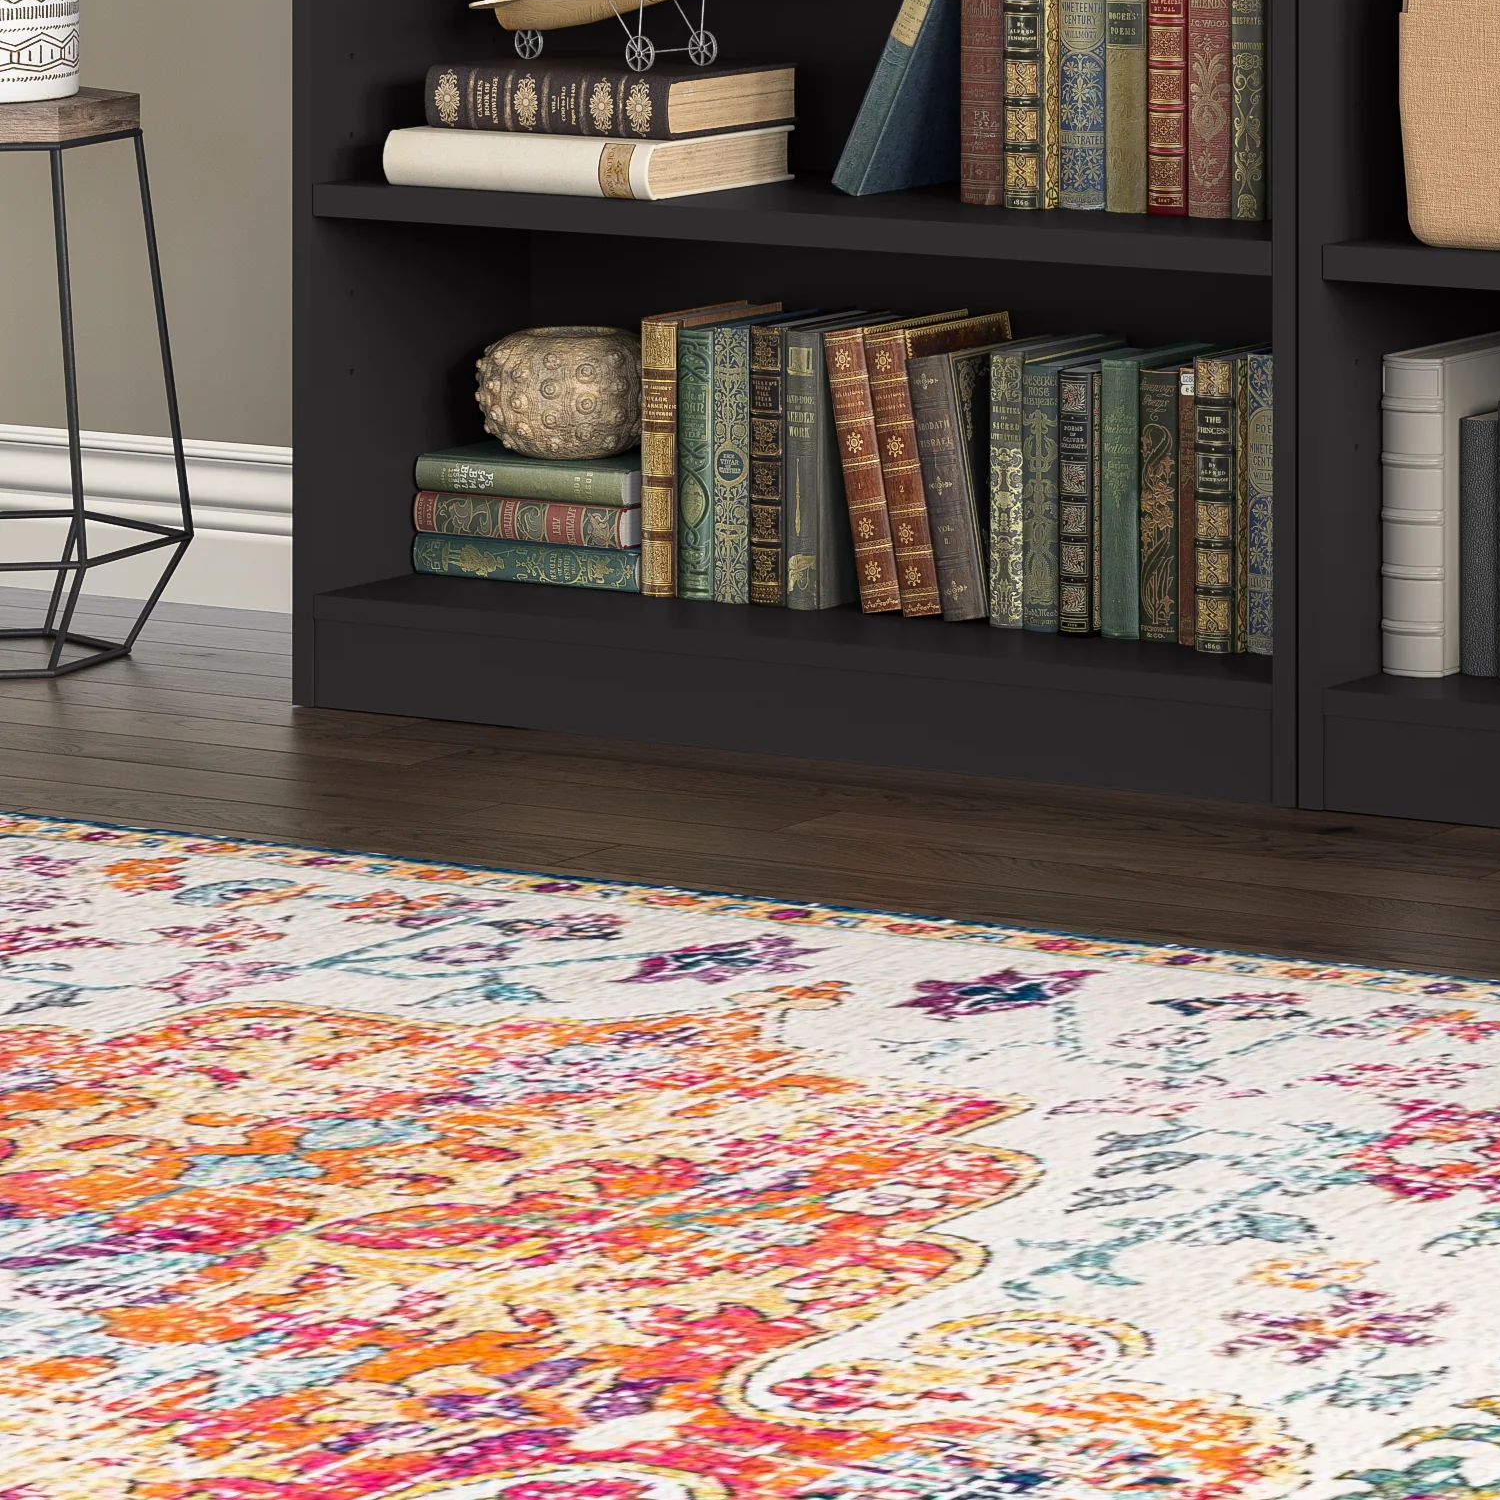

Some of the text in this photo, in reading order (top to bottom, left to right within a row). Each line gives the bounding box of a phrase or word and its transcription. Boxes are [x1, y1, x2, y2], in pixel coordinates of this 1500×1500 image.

[1061, 2, 1103, 13] NINETEENTH
[1064, 14, 1098, 25] CENTURY
[1110, 27, 1136, 36] POEMS
[484, 81, 490, 92] OF
[491, 75, 499, 124] KNOWLEDGE
[787, 411, 815, 423] NEEDLE
[1204, 416, 1222, 424] THE
[1262, 415, 1272, 423] TH
[788, 426, 811, 438] WORK
[992, 422, 1020, 431] SACRED
[1255, 423, 1272, 433] POE
[1250, 442, 1273, 454] NINETE
[1253, 456, 1272, 467] CENT
[484, 472, 494, 488] PS
[899, 484, 904, 493] 2
[552, 517, 562, 536] ART
[549, 553, 557, 580] RIDER
[563, 555, 571, 581] HORSE
[1249, 579, 1273, 589] ILLUST
